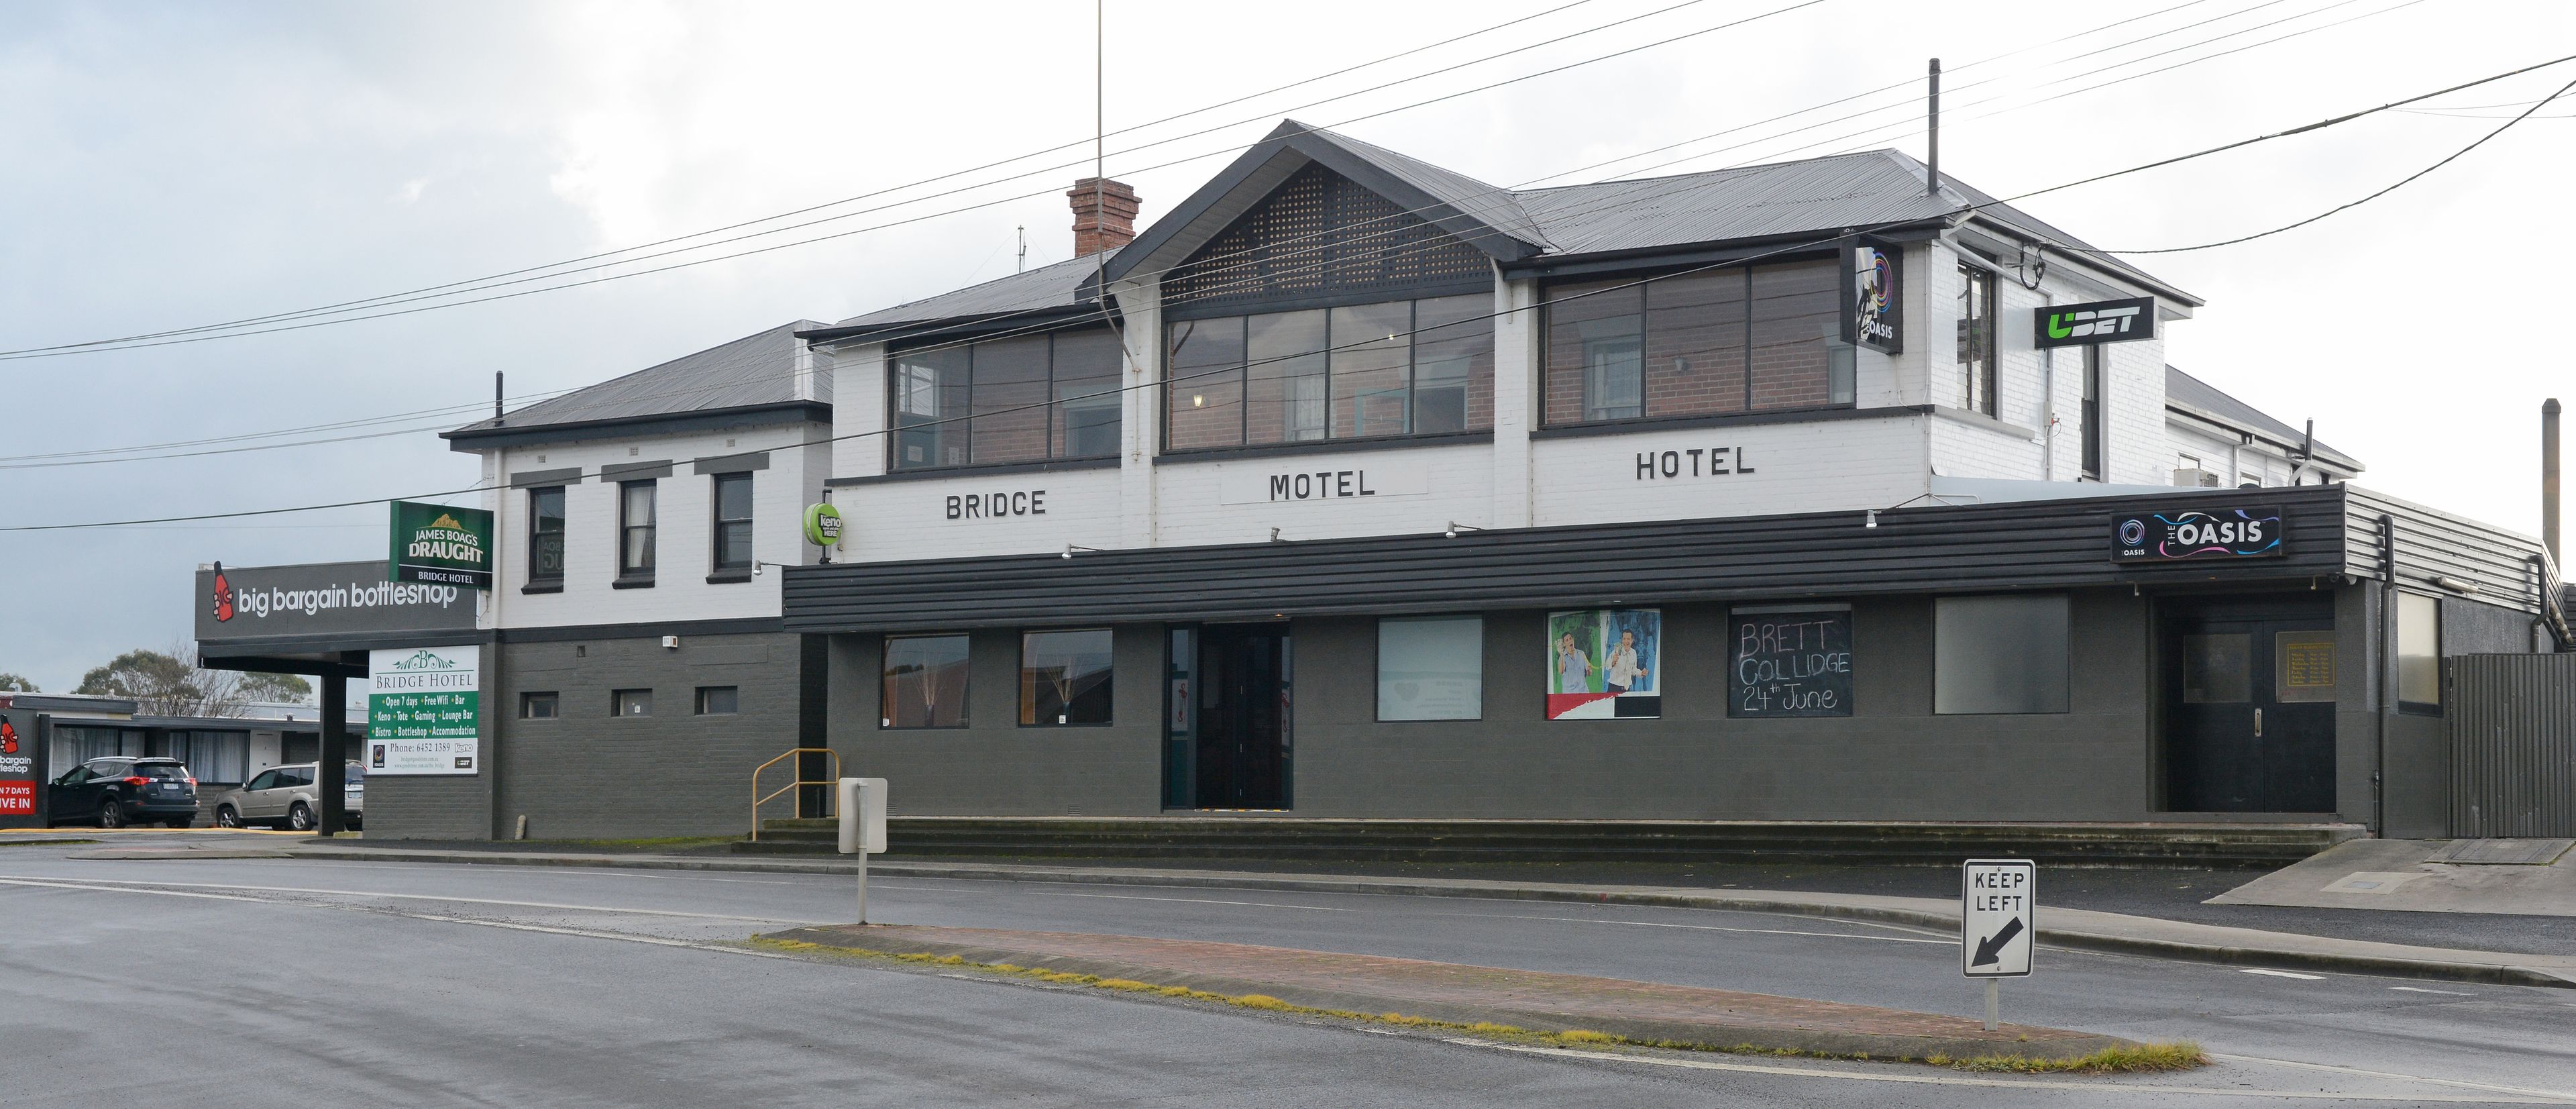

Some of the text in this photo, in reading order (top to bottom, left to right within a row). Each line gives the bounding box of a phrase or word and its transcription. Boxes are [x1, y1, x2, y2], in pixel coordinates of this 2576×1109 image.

[1869, 320, 1893, 339] OASIS
[2048, 307, 2141, 339] UBET
[1637, 447, 1755, 480] HOTEL
[1271, 470, 1375, 500] MOTEL
[947, 490, 1046, 519] BRIDGE
[415, 529, 478, 547] JAMES BOAG'S
[2167, 521, 2262, 546] THE OASIS
[409, 541, 484, 563] DRAUGHT
[418, 571, 474, 584] BRIDGE HOTEL
[239, 581, 458, 618] big bargain bottleshop
[1740, 621, 1834, 658] BRETT
[1739, 652, 1850, 685] COLLIDGE
[376, 674, 472, 689] BRIDGE HOTEL
[386, 694, 465, 708] Open 7 days Free Wifi Bar
[1743, 683, 1837, 710] 24th June
[378, 709, 473, 723] Keno Tote Gaming Lounge Bar
[375, 725, 476, 738] Bistro Bottleshop Accommodation
[390, 742, 451, 752] Phone: 6452 1389
[19, 798, 30, 808] IN
[1976, 873, 2024, 888] KEEP
[1977, 896, 2022, 911] LEFT
